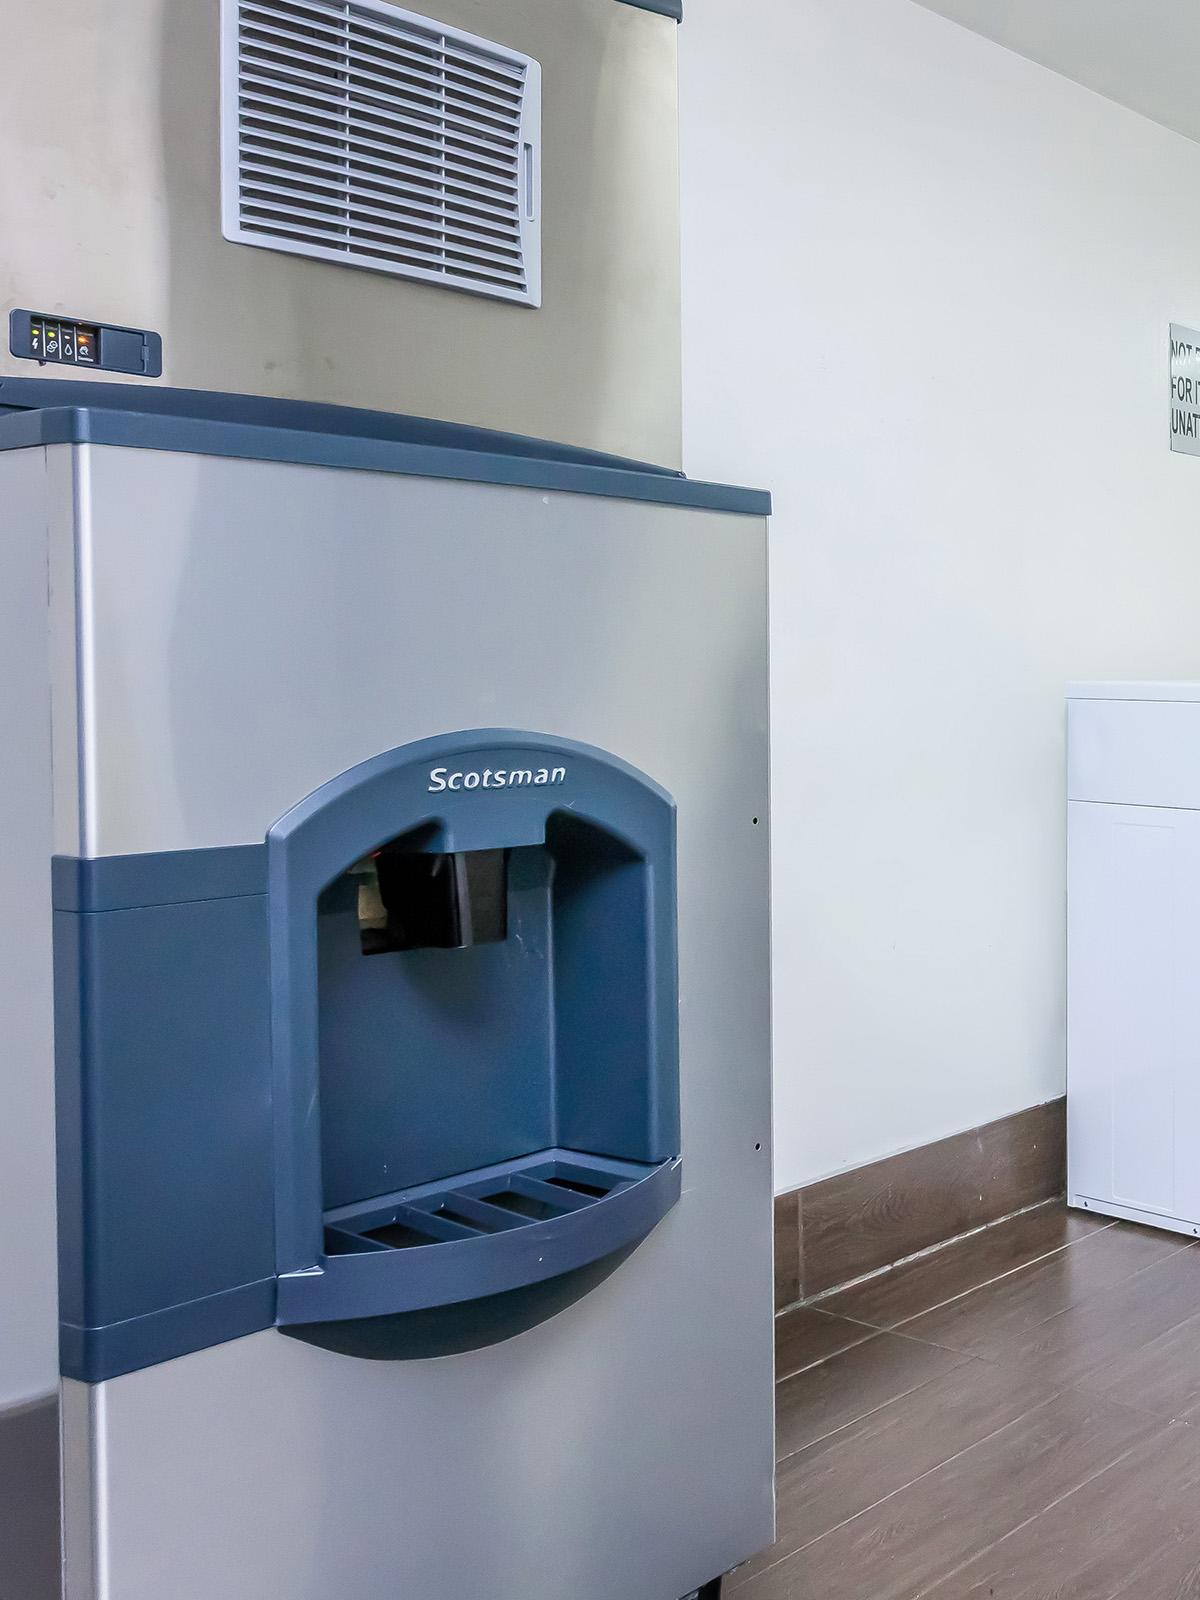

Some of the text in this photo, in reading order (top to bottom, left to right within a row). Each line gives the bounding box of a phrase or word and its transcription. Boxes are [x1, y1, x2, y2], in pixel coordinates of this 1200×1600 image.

[1171, 339, 1193, 365] NOT
[1171, 376, 1193, 404] FOR
[427, 766, 566, 793] Scotsman
